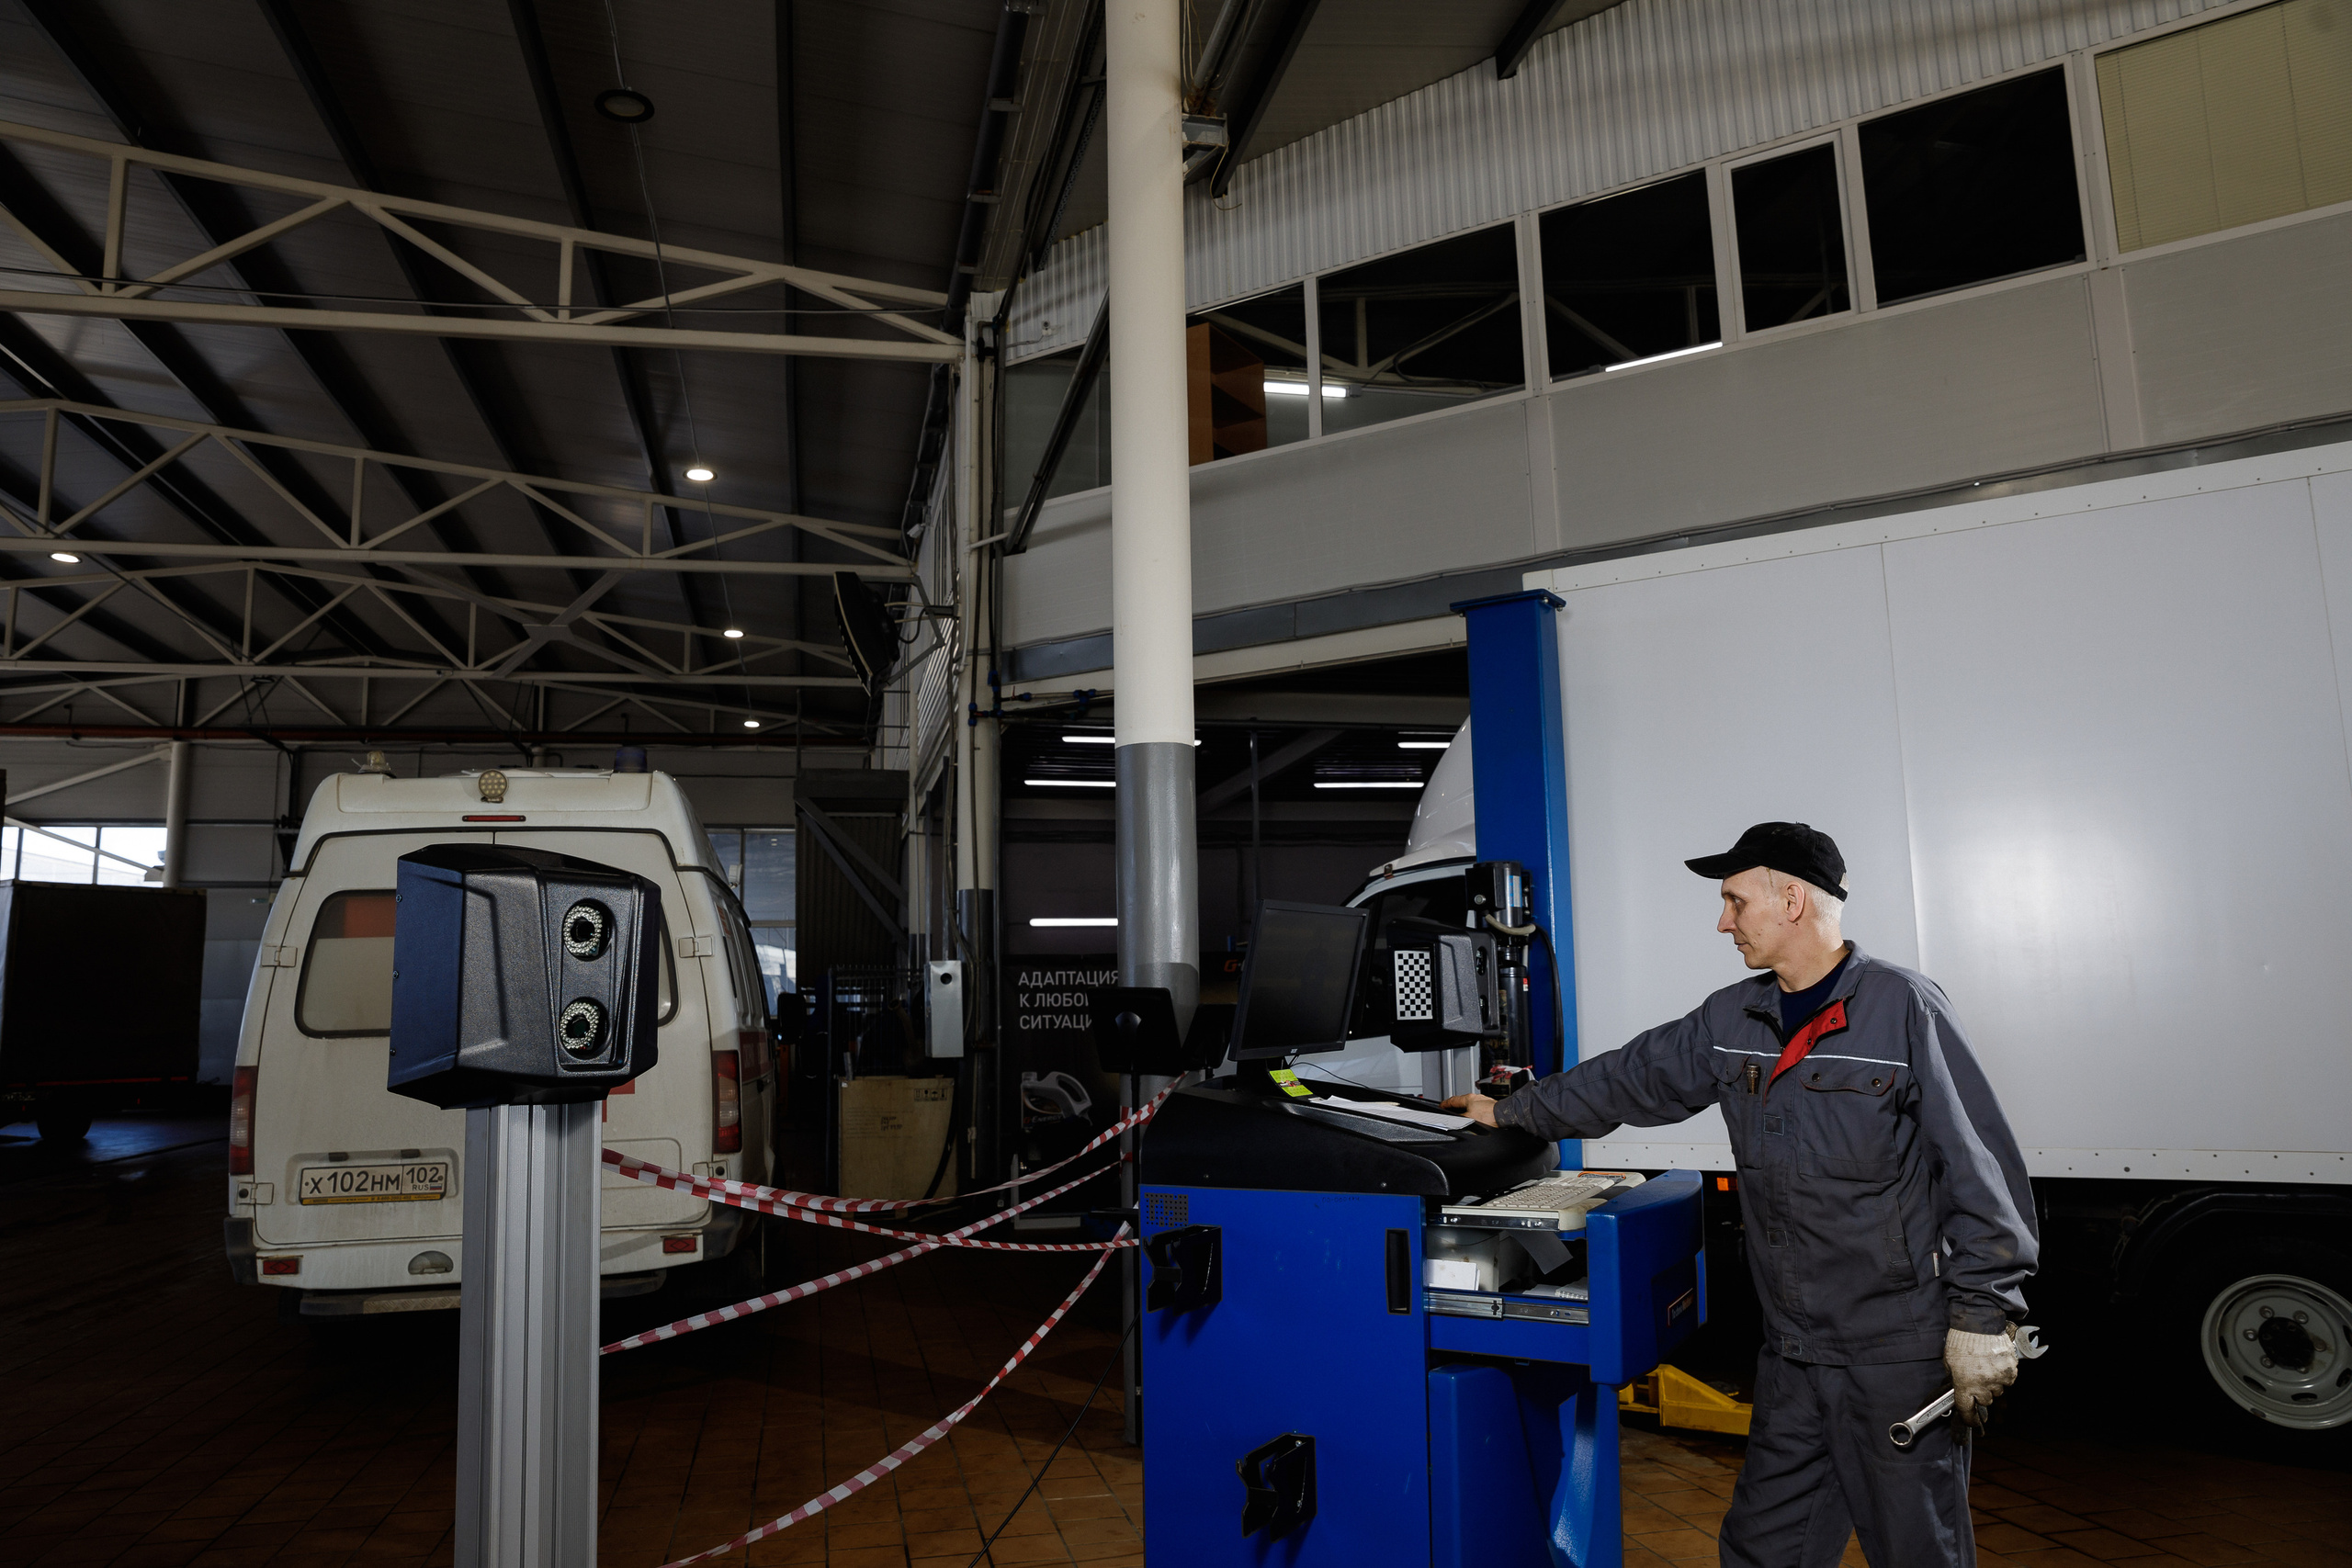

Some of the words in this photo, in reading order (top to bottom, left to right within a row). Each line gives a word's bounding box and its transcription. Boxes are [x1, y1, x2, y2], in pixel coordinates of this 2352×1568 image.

[1018, 970, 1118, 988] АДАПТАЦИЯ
[1019, 993, 1030, 1008] К
[405, 1167, 439, 1184] 102
[413, 1183, 429, 1191] RUS
